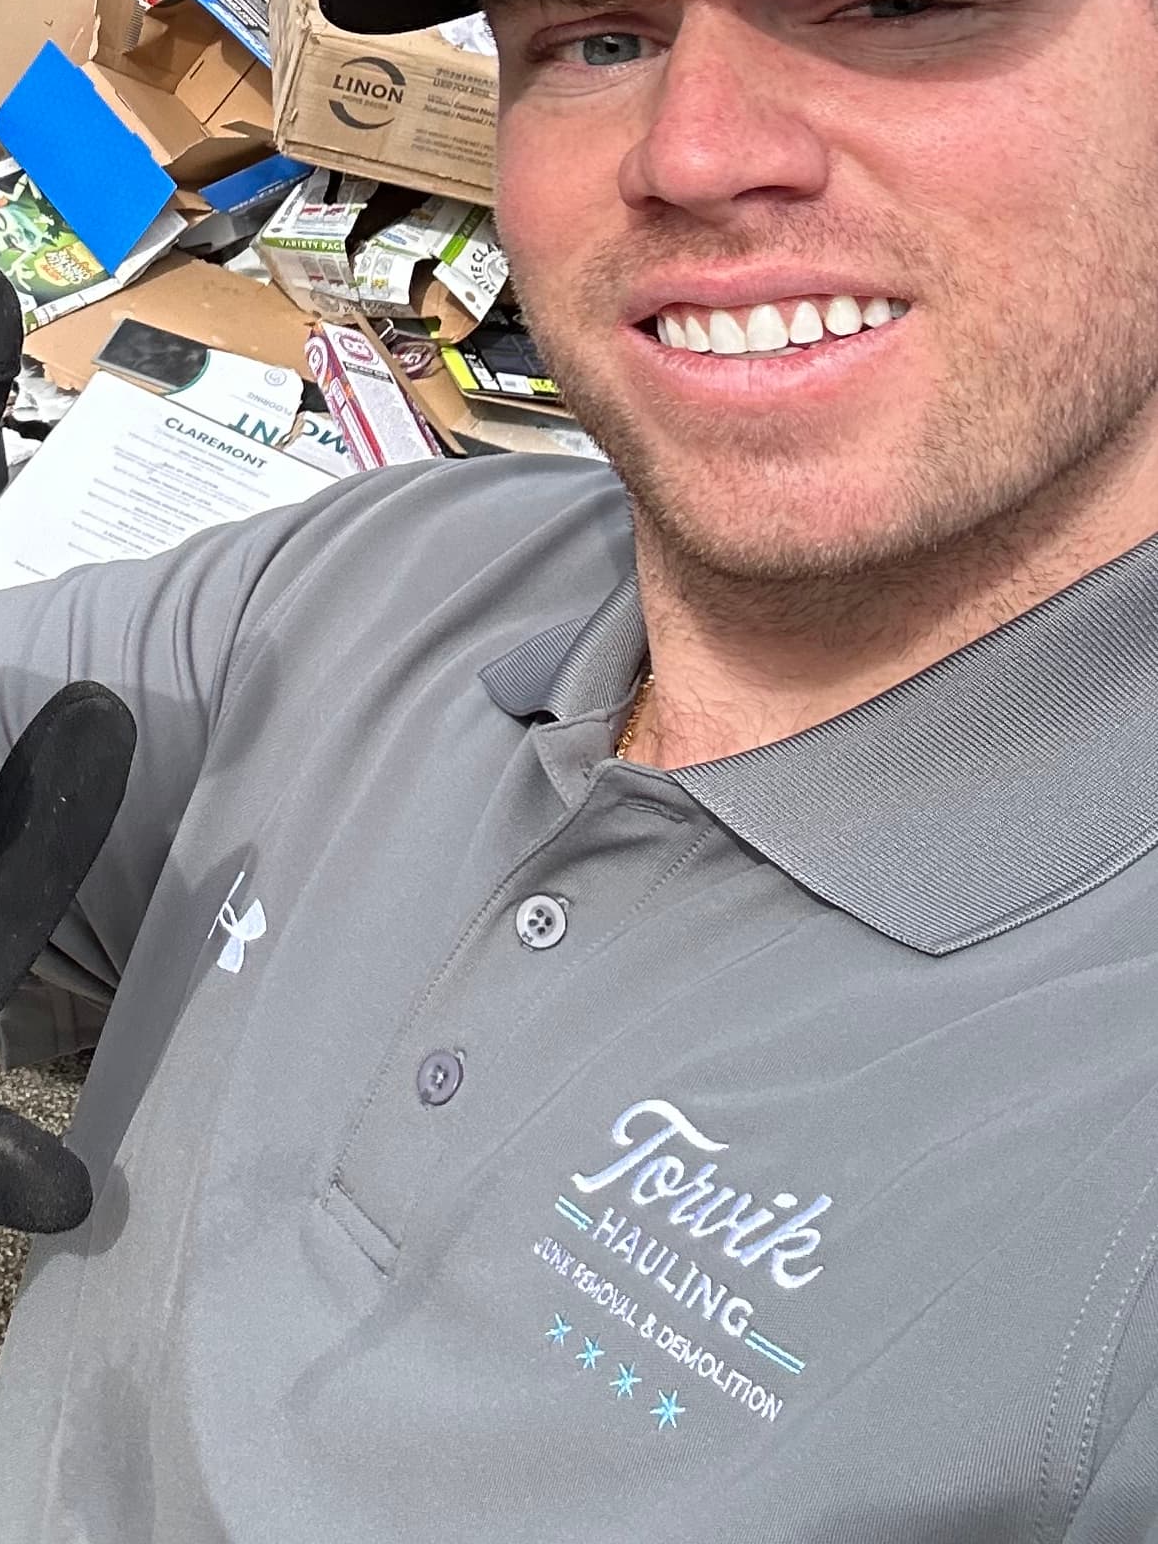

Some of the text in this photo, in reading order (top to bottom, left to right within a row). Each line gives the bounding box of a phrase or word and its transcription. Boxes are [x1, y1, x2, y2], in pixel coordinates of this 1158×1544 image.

[332, 74, 404, 103] LINON
[278, 238, 318, 249] VARIETY
[245, 390, 294, 416] FLOORING
[162, 415, 269, 470] CLAREMONT
[570, 1098, 833, 1289] Torvik
[592, 1207, 753, 1338] HAULING
[571, 1262, 639, 1328] REMOVAL
[640, 1312, 657, 1339] &
[656, 1325, 783, 1422] DEMOLITION
